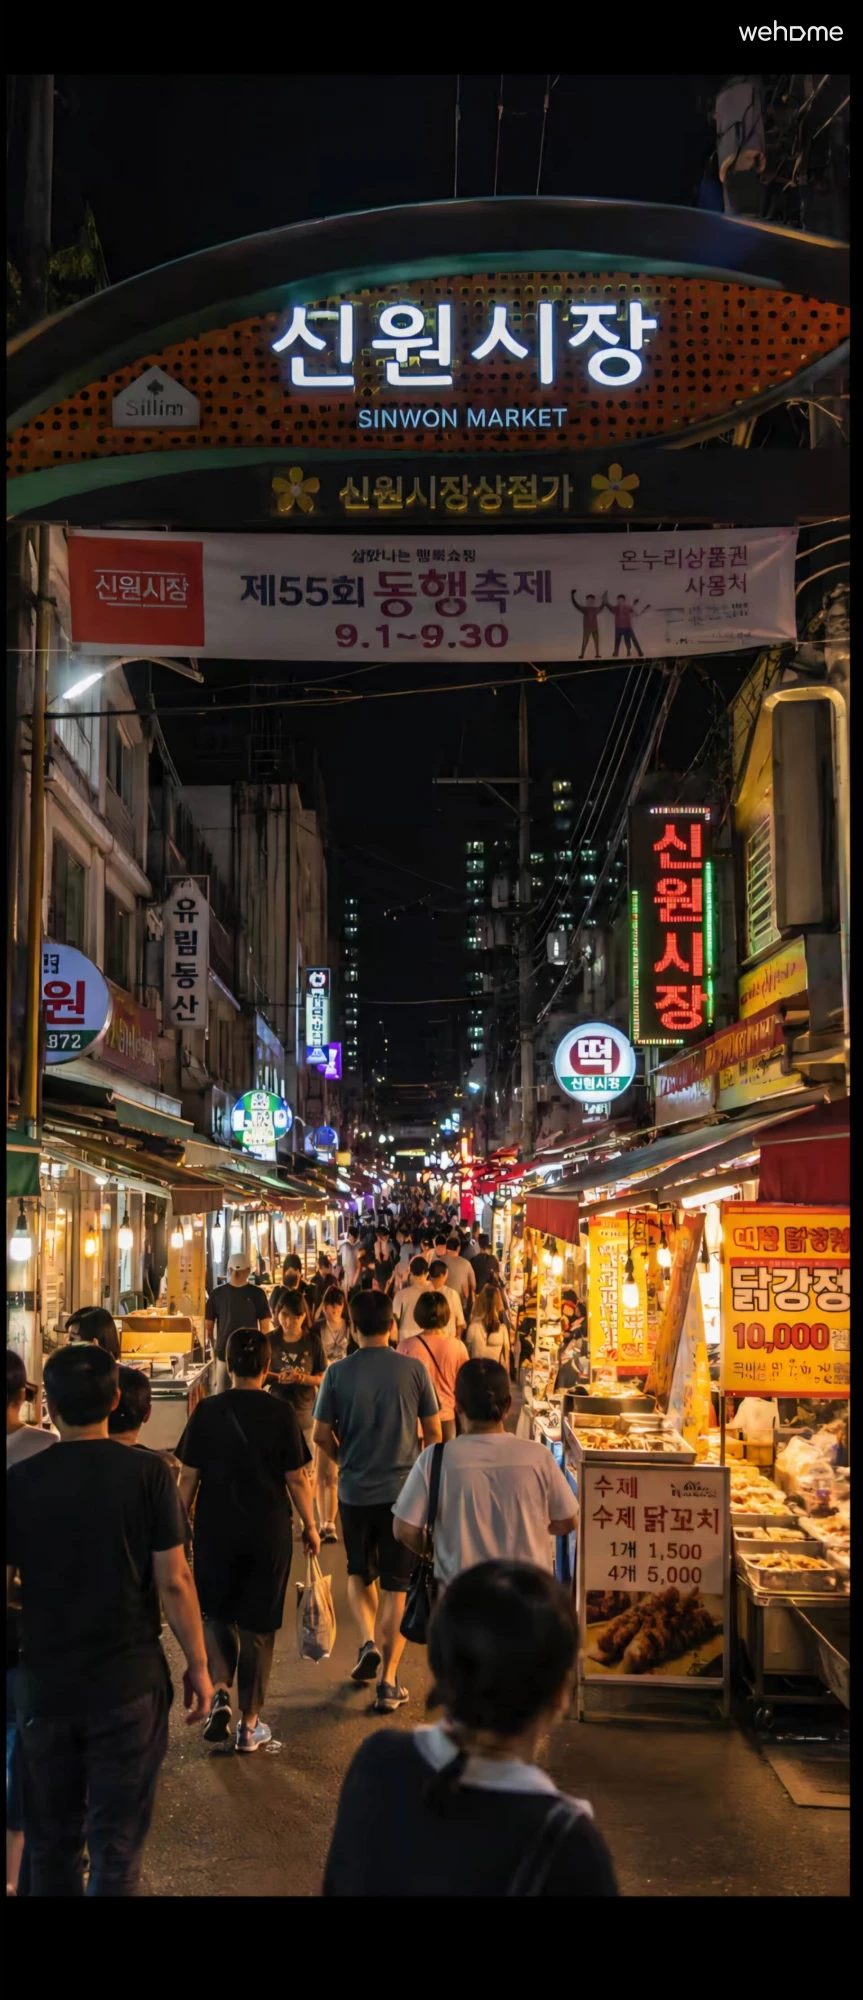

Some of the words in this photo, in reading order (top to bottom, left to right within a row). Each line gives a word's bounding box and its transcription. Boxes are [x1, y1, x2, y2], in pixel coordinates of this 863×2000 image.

[271, 300, 658, 387] 신원시장
[125, 399, 184, 417] Sillim
[358, 408, 458, 429] SINWON
[467, 407, 568, 428] MARKET
[95, 575, 190, 602] 신원시장
[240, 574, 365, 608] 제55회
[335, 623, 509, 649] 9.1~9.30
[653, 824, 709, 1031] 신원시장
[171, 897, 199, 1022] 유림동산
[577, 1038, 613, 1075] 떡
[731, 1266, 850, 1313] 닭강정
[593, 1475, 639, 1500] 수제
[592, 1504, 637, 1532] 수제
[644, 1504, 720, 1535] 닭꼬치
[610, 1541, 637, 1560] 1개
[649, 1542, 702, 1561] 1,500
[608, 1564, 637, 1583] 4개
[647, 1565, 702, 1586] 5,000
